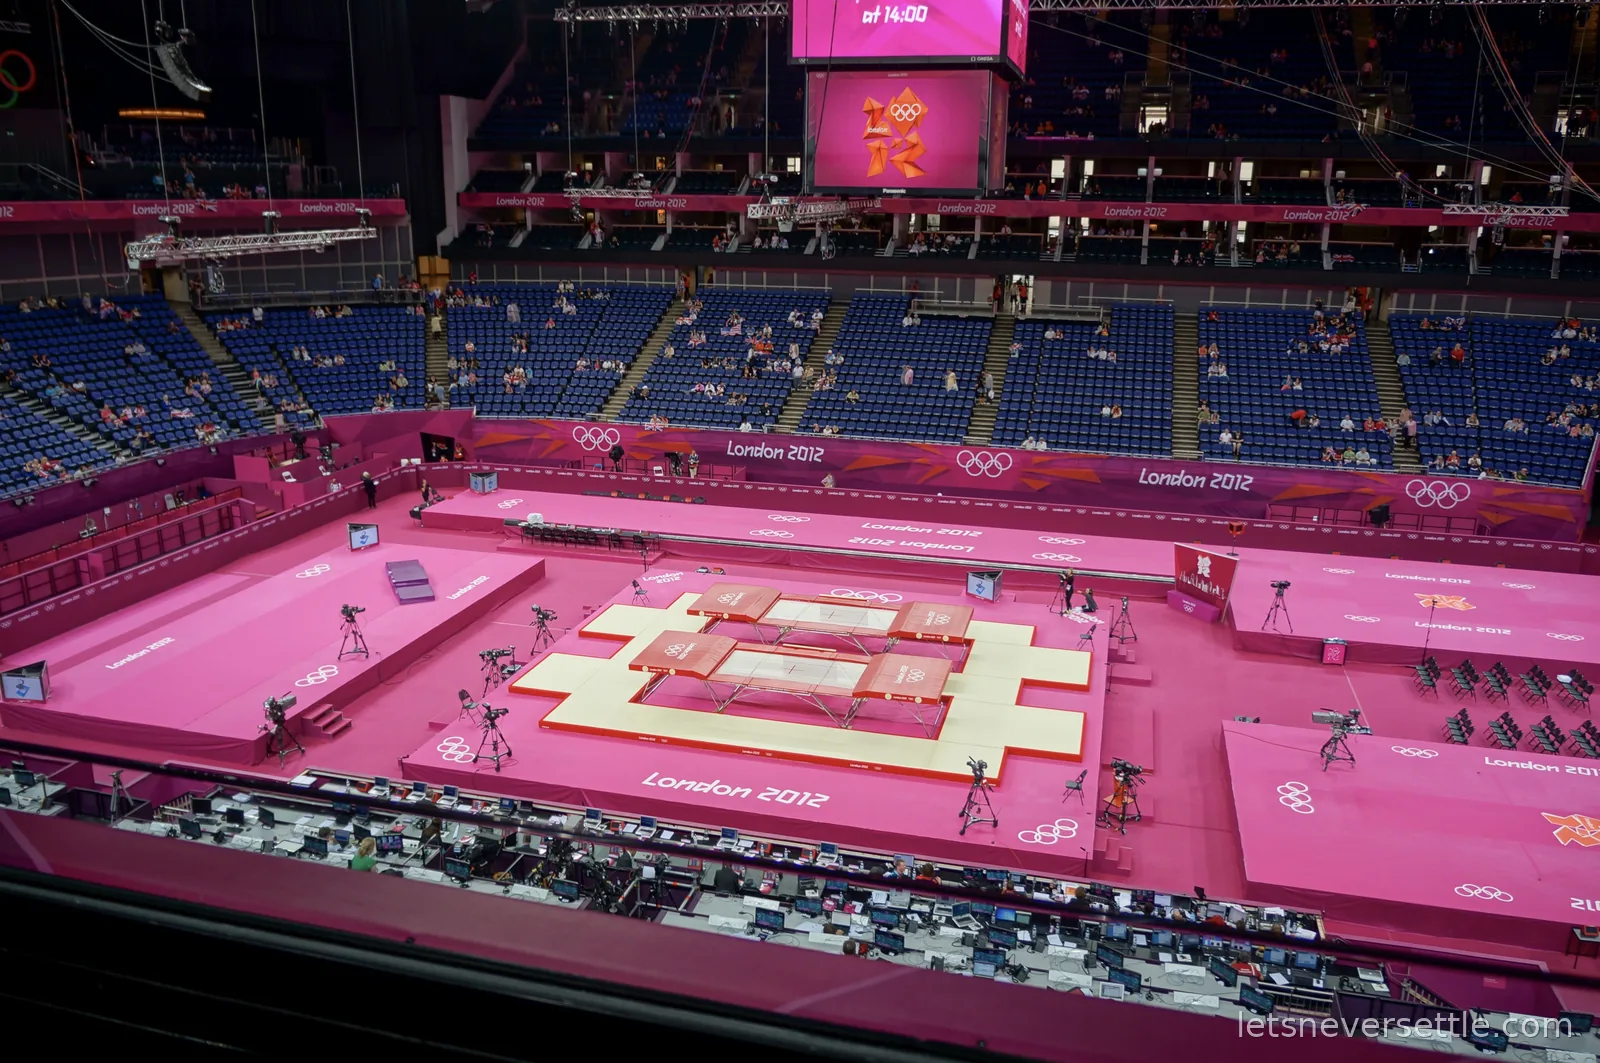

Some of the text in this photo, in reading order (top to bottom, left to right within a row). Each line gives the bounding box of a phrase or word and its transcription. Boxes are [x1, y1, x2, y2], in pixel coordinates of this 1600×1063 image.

[862, 5, 928, 24] at 14:00
[496, 196, 545, 206] London 2012
[635, 199, 687, 208] London 2012
[132, 203, 195, 215] London 2012
[300, 203, 356, 213] London 2012
[937, 203, 996, 214] London 2012
[1104, 206, 1168, 217] London 2012
[1283, 209, 1350, 221] London 2012
[1527, 216, 1555, 227] 2012
[727, 440, 825, 463] London 2012
[1138, 467, 1254, 492] London 2012
[861, 522, 983, 537] London 2012
[847, 536, 975, 553] London 2012
[642, 571, 685, 581] London
[656, 576, 682, 584] 2012
[1385, 573, 1436, 581] London
[446, 584, 477, 600] London
[1415, 621, 1512, 635] London 2012
[105, 636, 176, 670] London 2012
[1484, 757, 1600, 777] London 201
[641, 771, 830, 808] London 2012
